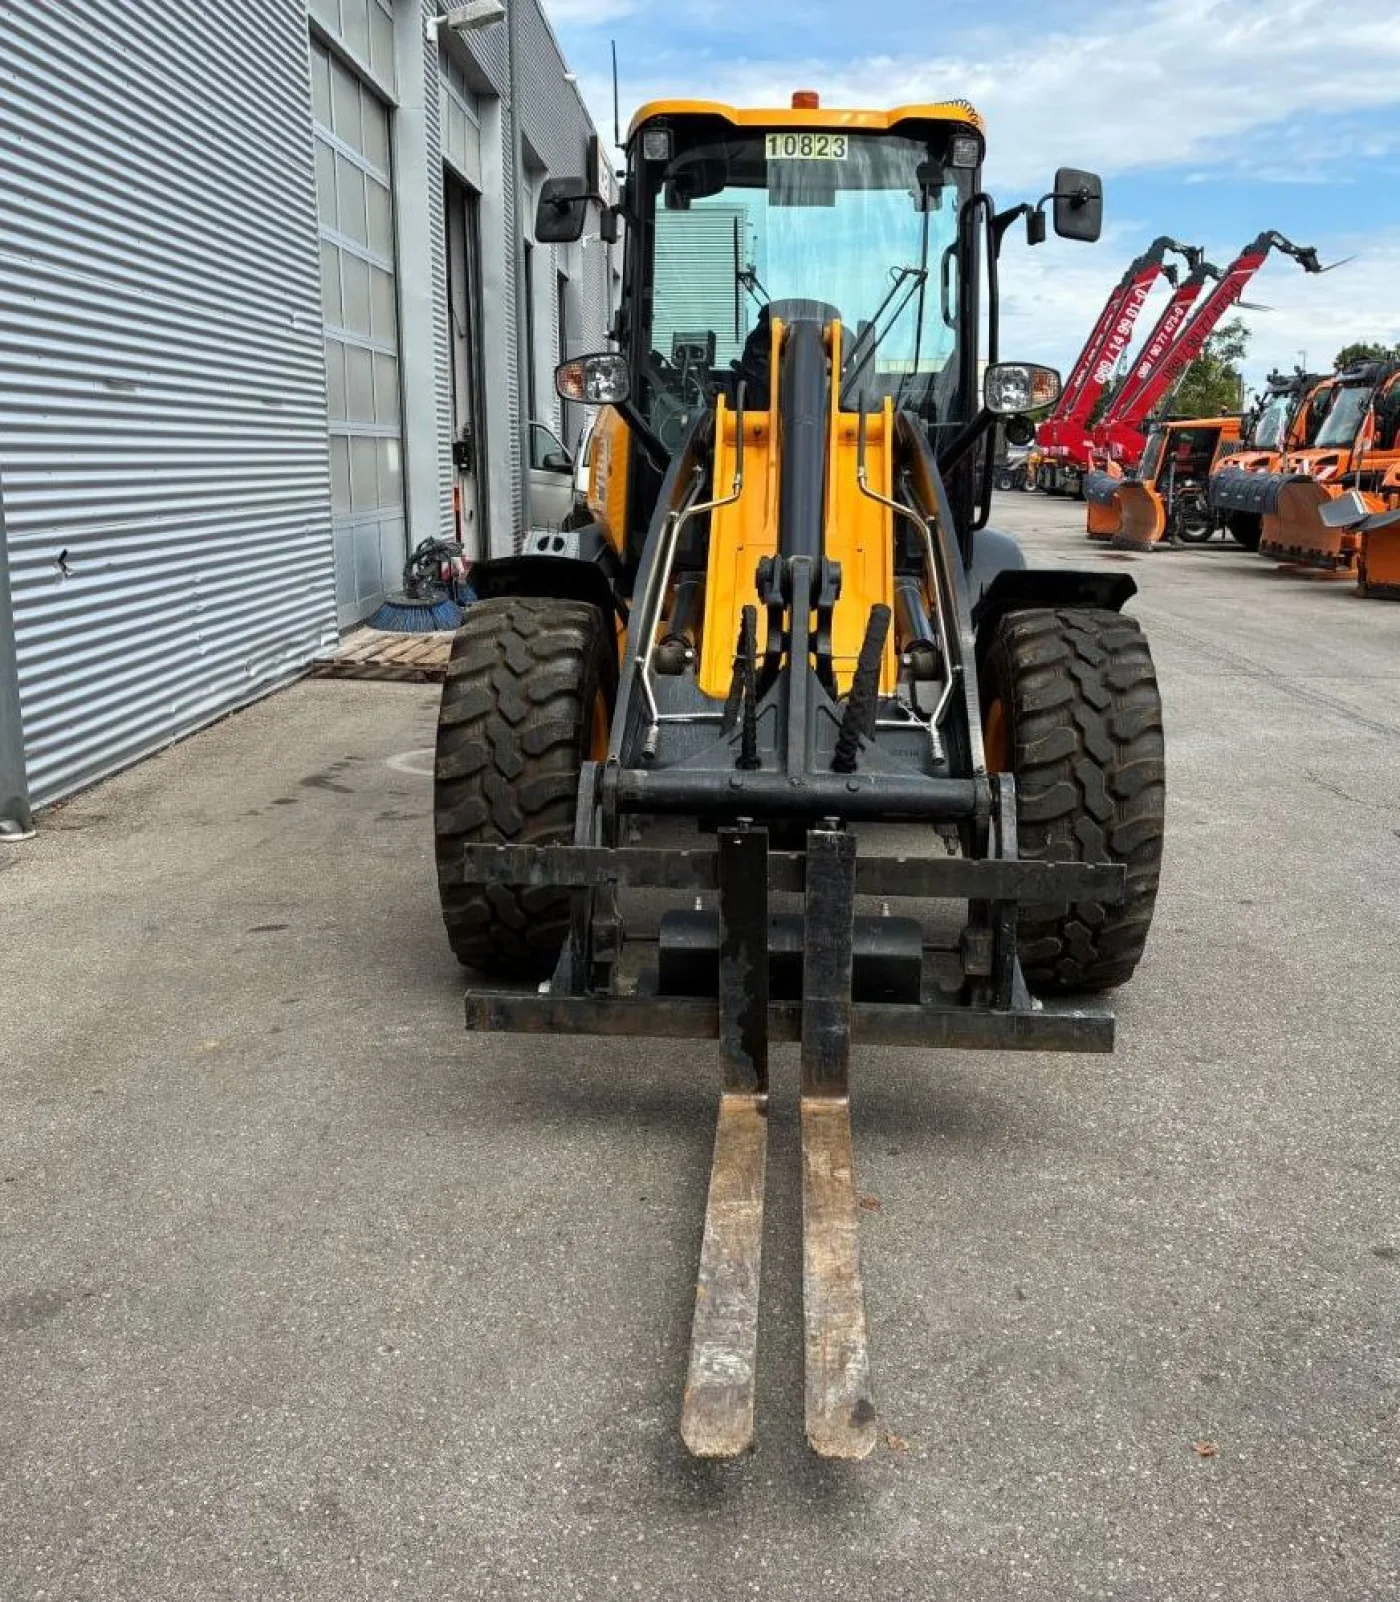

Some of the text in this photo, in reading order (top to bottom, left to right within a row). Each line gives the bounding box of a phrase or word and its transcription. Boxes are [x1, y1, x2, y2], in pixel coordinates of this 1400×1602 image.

[768, 135, 845, 158] 10823
[1116, 318, 1133, 335] 99
[1108, 334, 1125, 351] 14
